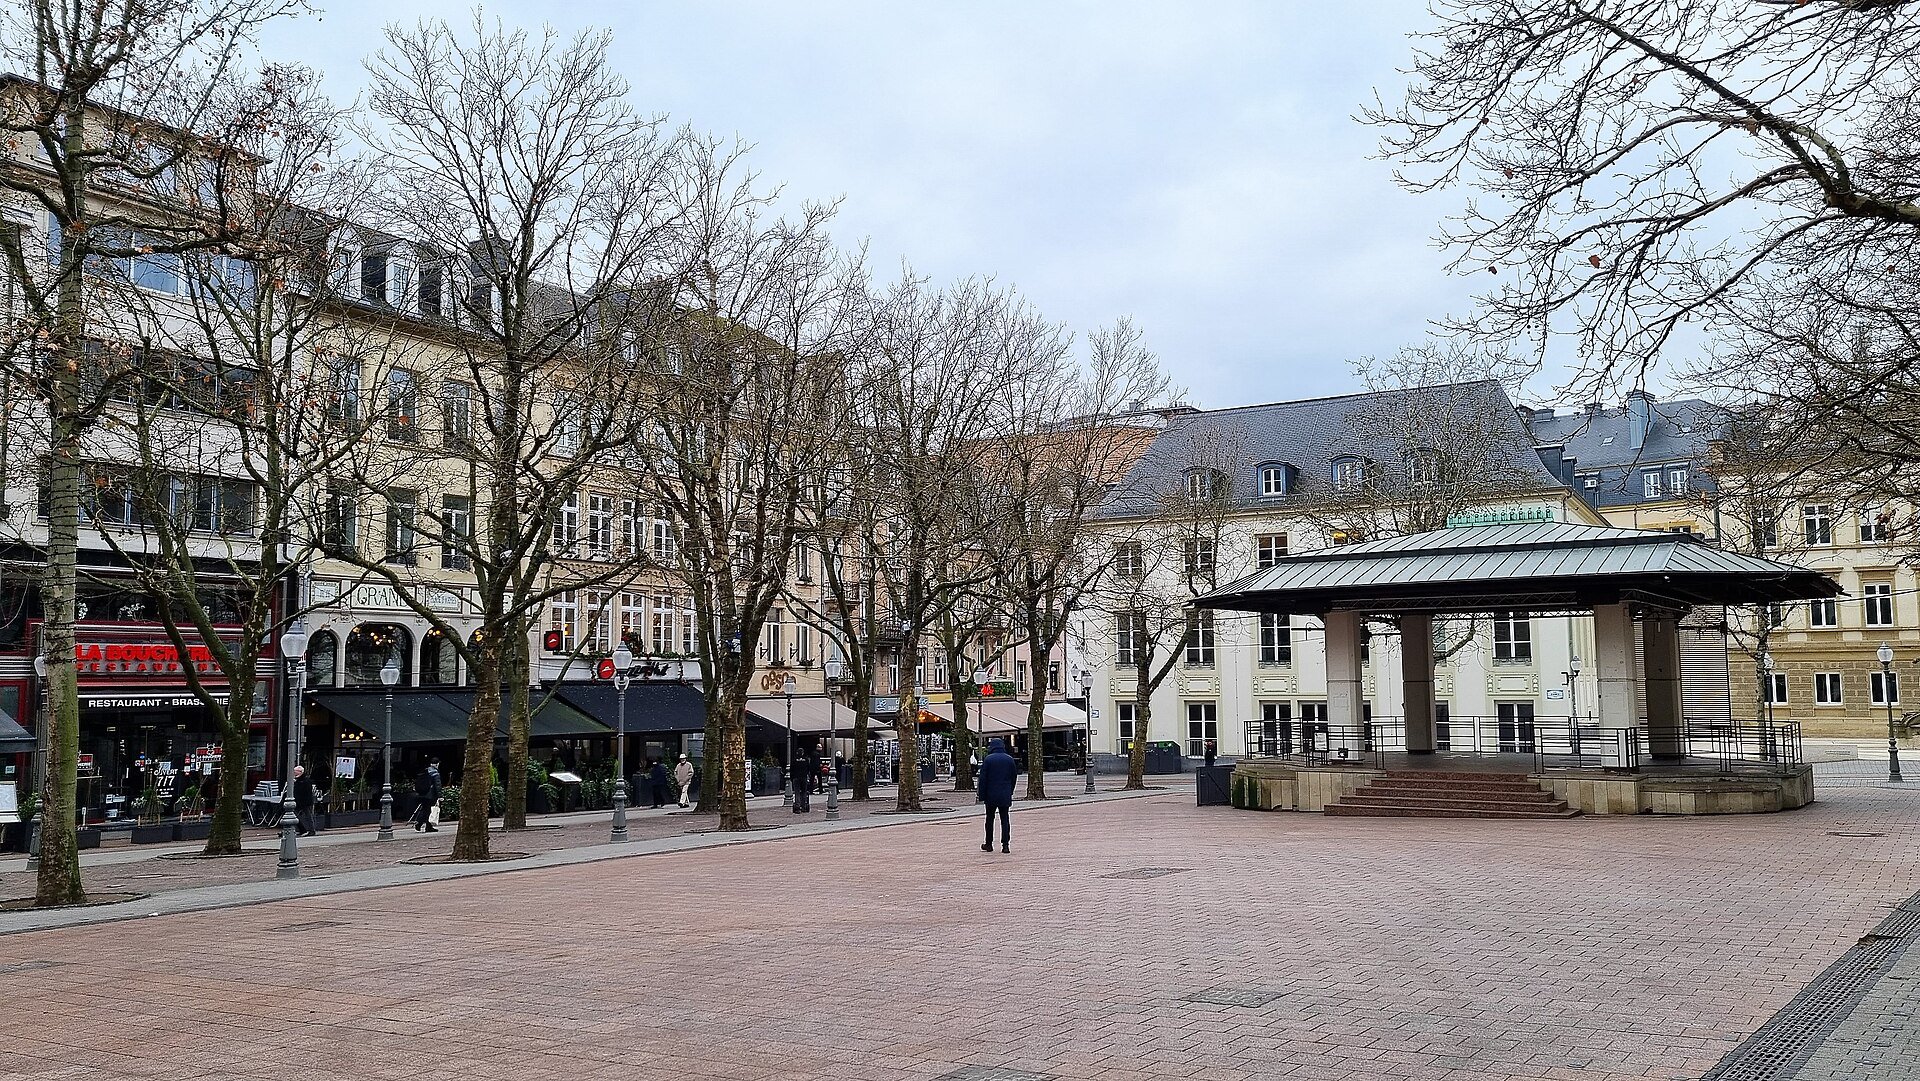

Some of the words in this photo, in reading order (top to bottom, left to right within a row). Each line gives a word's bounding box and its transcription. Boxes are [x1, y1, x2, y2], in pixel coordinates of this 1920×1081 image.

[76, 644, 102, 660] LA
[106, 645, 214, 661] BOUCHRI
[88, 698, 161, 708] RESTAURANT
[172, 698, 229, 706] BRASRIE
[157, 775, 175, 787] 7/7
